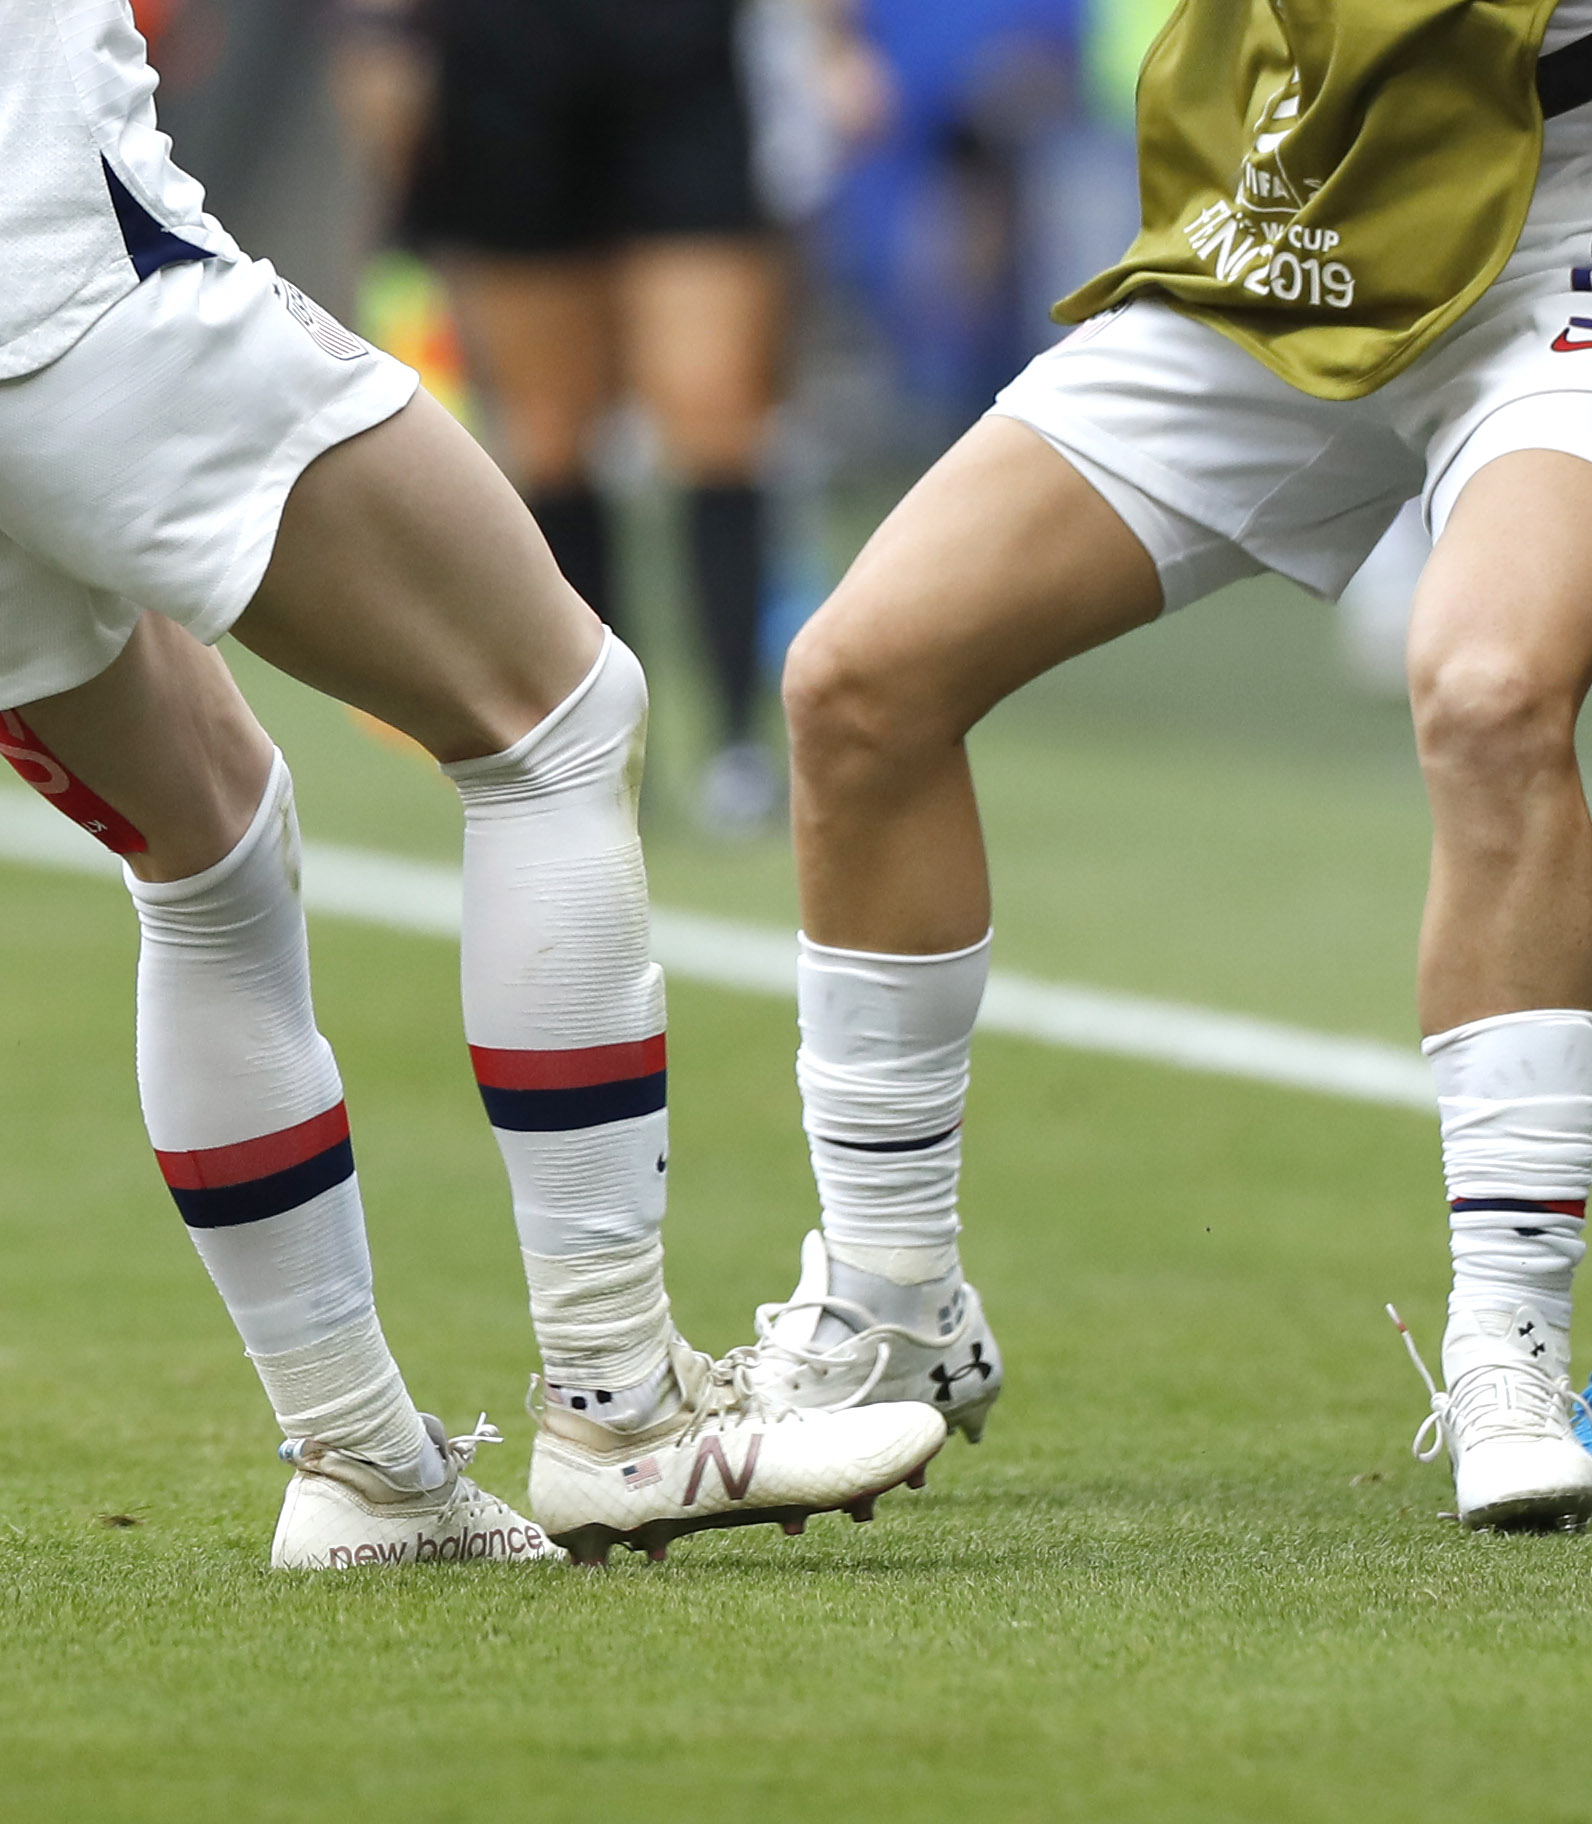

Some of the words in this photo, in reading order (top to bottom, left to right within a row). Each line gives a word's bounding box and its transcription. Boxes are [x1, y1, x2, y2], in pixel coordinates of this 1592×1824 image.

[1287, 224, 1340, 253] CUP
[1243, 243, 1356, 308] 2019
[329, 1541, 408, 1569] new
[415, 1523, 544, 1564] balance
